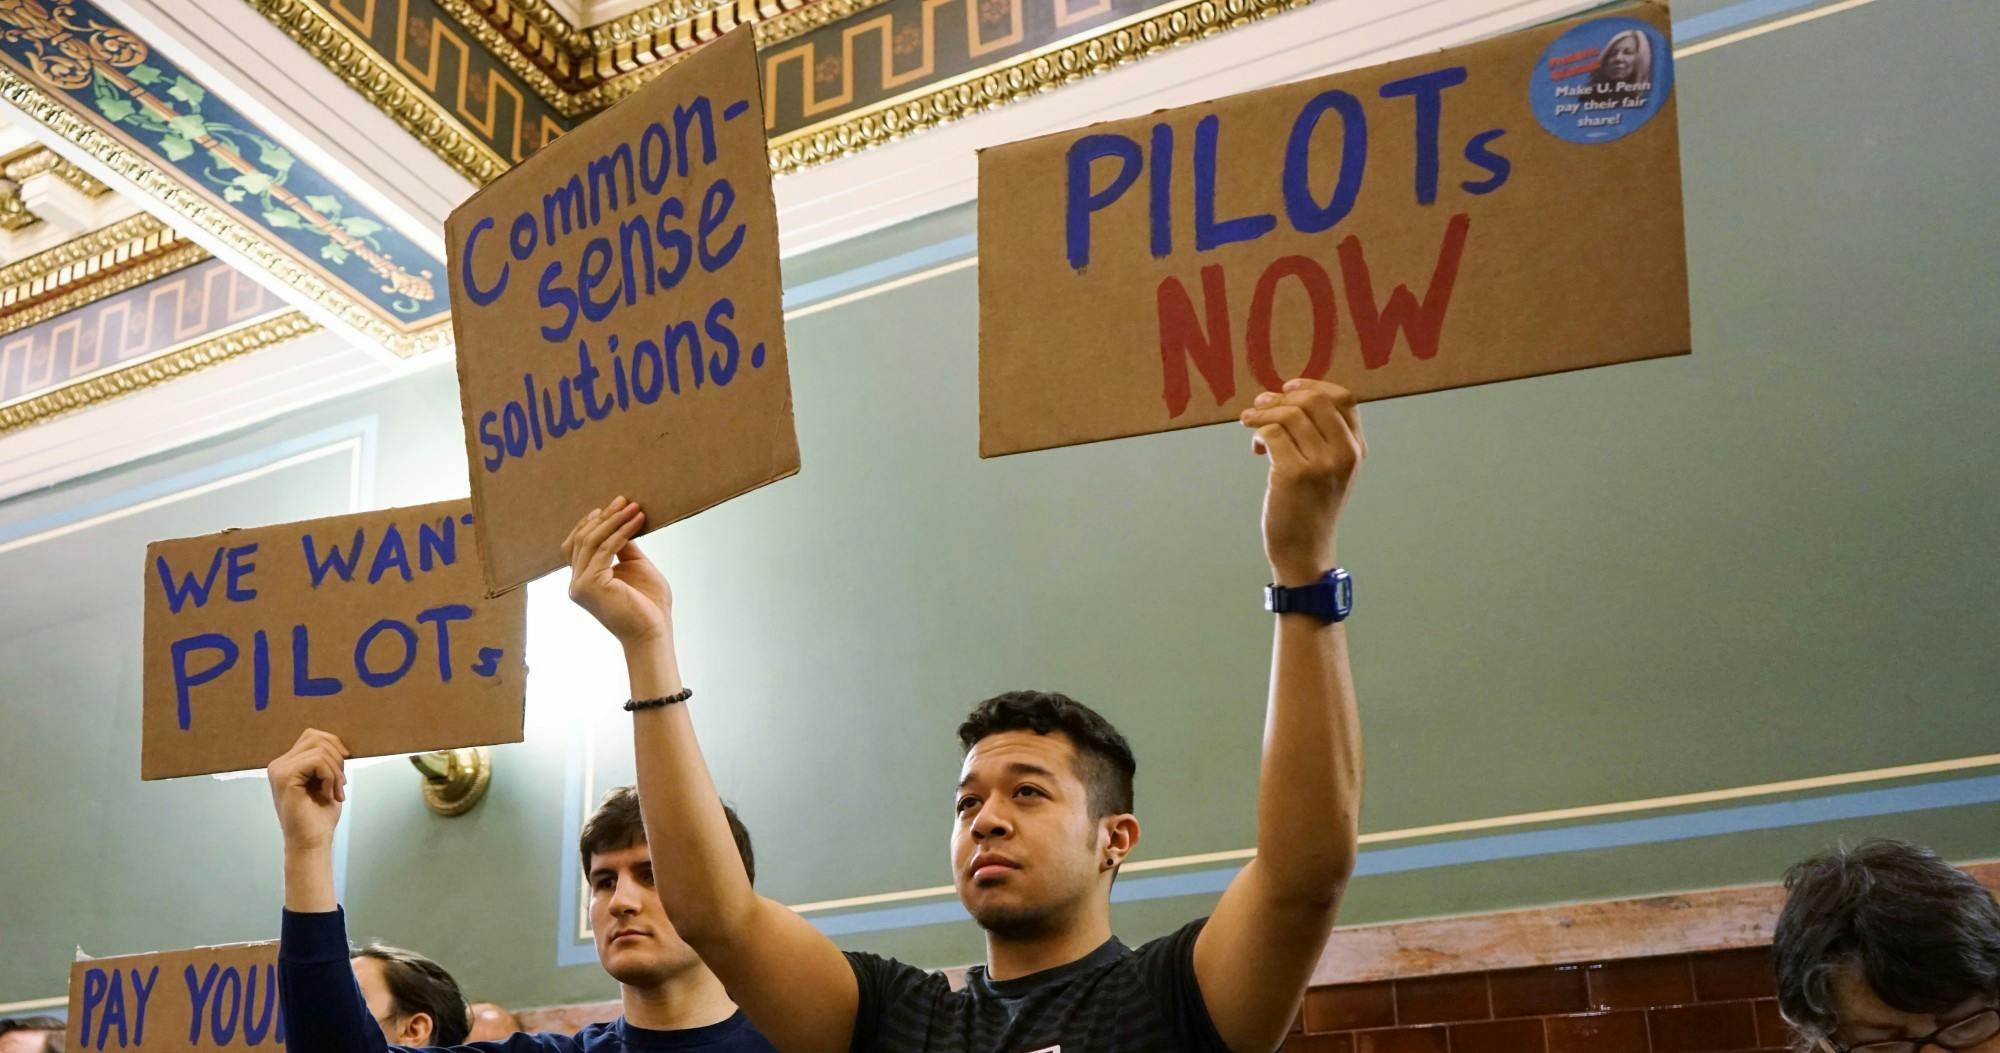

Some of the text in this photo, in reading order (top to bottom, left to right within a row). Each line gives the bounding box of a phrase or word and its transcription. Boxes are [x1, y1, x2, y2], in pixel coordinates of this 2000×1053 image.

[1555, 81, 1651, 97] Make U. Penn
[1555, 96, 1647, 116] pay their fair
[1577, 114, 1621, 127] share!
[462, 95, 750, 306] Common-
[538, 178, 746, 343] sense
[1156, 213, 1471, 419] NOW
[479, 298, 766, 473] solutions.
[156, 543, 258, 615] WE
[80, 965, 160, 1051] PAY
